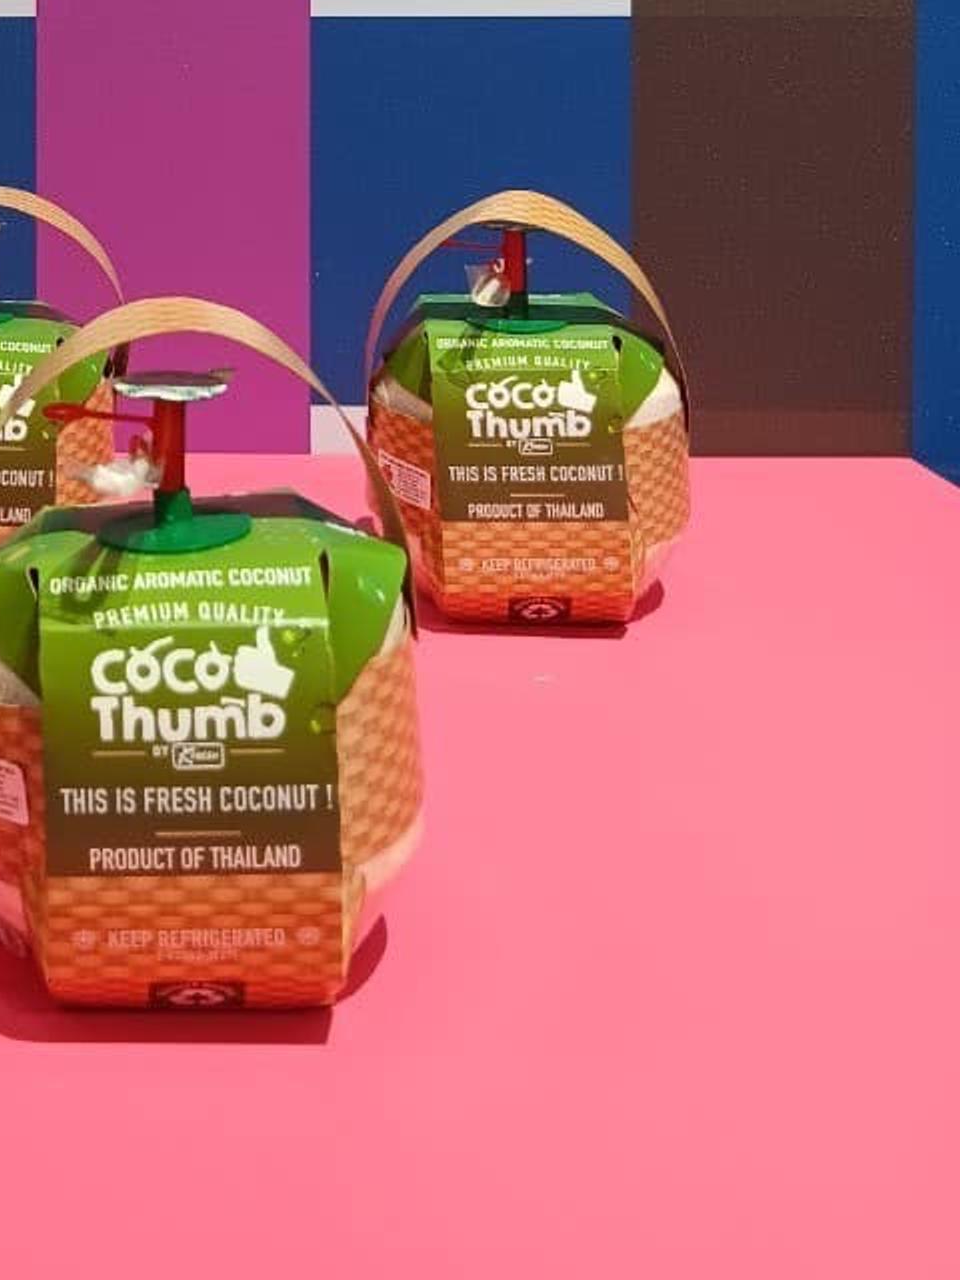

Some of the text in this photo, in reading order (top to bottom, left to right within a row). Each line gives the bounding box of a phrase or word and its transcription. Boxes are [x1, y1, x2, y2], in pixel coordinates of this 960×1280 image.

[0, 340, 51, 353] COCONUT
[436, 338, 609, 350] ORGANIC AROMATIC COCONUT
[466, 355, 591, 371] PREMIUM QUALITY
[466, 410, 592, 438] Thumb
[448, 466, 479, 482] THIS
[484, 466, 497, 482] IS
[501, 466, 545, 482] FRESH
[550, 465, 614, 482] COCONUT
[468, 502, 604, 519] PRODUCT OF THAILAND
[49, 566, 313, 595] ORGANIC AROMATIC COCONUT
[93, 601, 286, 630] PREMIUM QUALITY
[90, 693, 287, 742] Thumb
[60, 783, 334, 815] THIS IS FRESH COCONUT !
[90, 845, 301, 871] PRODUCT OF THAILAND
[108, 927, 285, 948] KEEP REFRIGERATED
